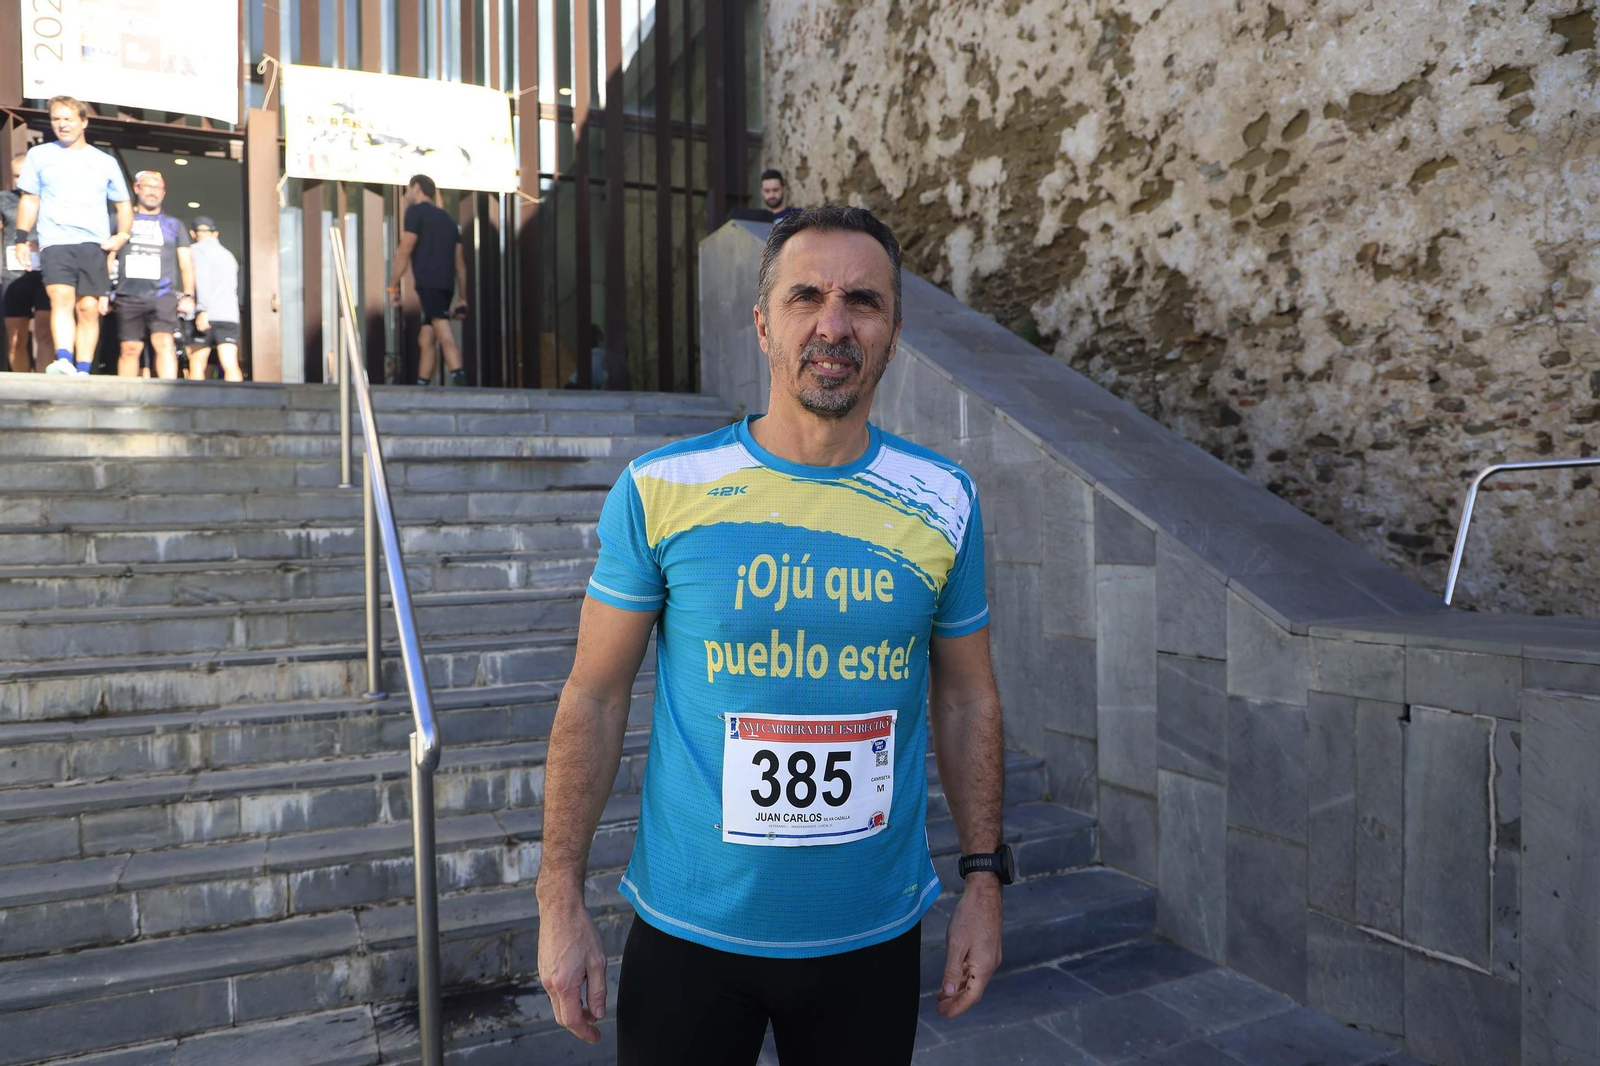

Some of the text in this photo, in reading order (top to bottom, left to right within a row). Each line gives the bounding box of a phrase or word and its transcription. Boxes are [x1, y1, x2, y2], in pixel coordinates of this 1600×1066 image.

[706, 485, 748, 496] 42K
[734, 553, 894, 613] ¡Ojú que
[703, 629, 915, 683] pueblo este!
[743, 718, 889, 735] XVI CARRERA DEL ESTRECHO
[750, 749, 852, 809] 385
[870, 775, 891, 783] CAMISETA
[876, 784, 885, 793] M
[755, 812, 780, 822] JUAN
[783, 812, 822, 823] CARLOS
